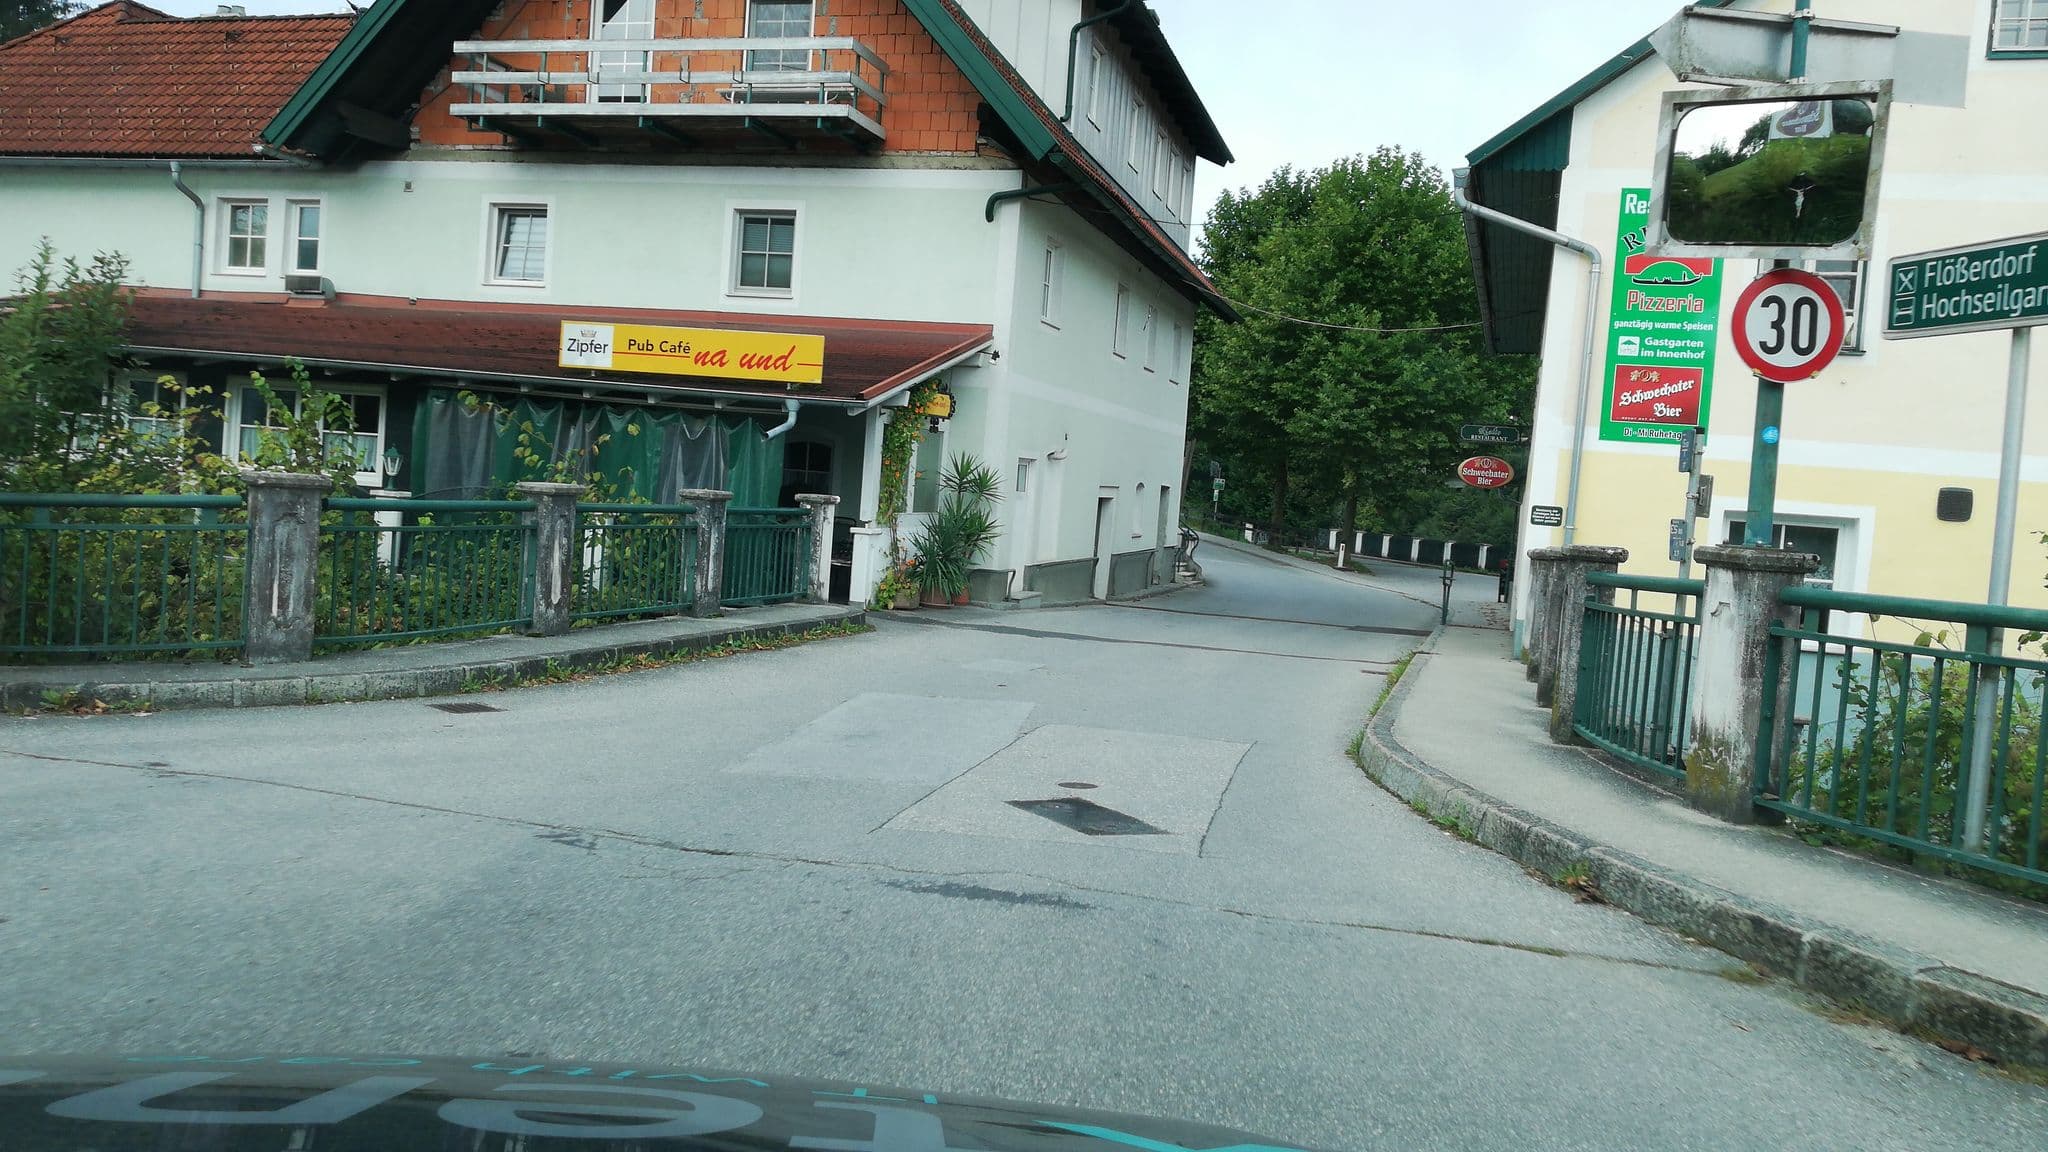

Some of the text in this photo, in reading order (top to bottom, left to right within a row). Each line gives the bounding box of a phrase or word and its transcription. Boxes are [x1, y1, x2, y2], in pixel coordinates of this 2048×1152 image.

[1924, 245, 2038, 287] Flößerdorf
[1627, 290, 1704, 312] Pizzeria
[1921, 284, 2048, 319] Hochseilgar
[1614, 320, 1713, 331] ganztägig warme Speisen
[1759, 295, 1818, 356] 30
[567, 338, 609, 357] Zipfer
[627, 339, 691, 354] Pub Café
[1645, 337, 1704, 348] Gastgarten
[693, 345, 796, 372] na und
[1641, 348, 1706, 359] im Innenhof
[1619, 379, 1695, 407] Schwechater
[1653, 402, 1682, 417] Bier
[1624, 427, 1633, 437] Di
[1649, 429, 1682, 440] Ruhetag
[1462, 467, 1509, 479] Schwechater
[1477, 476, 1492, 485] Bier
